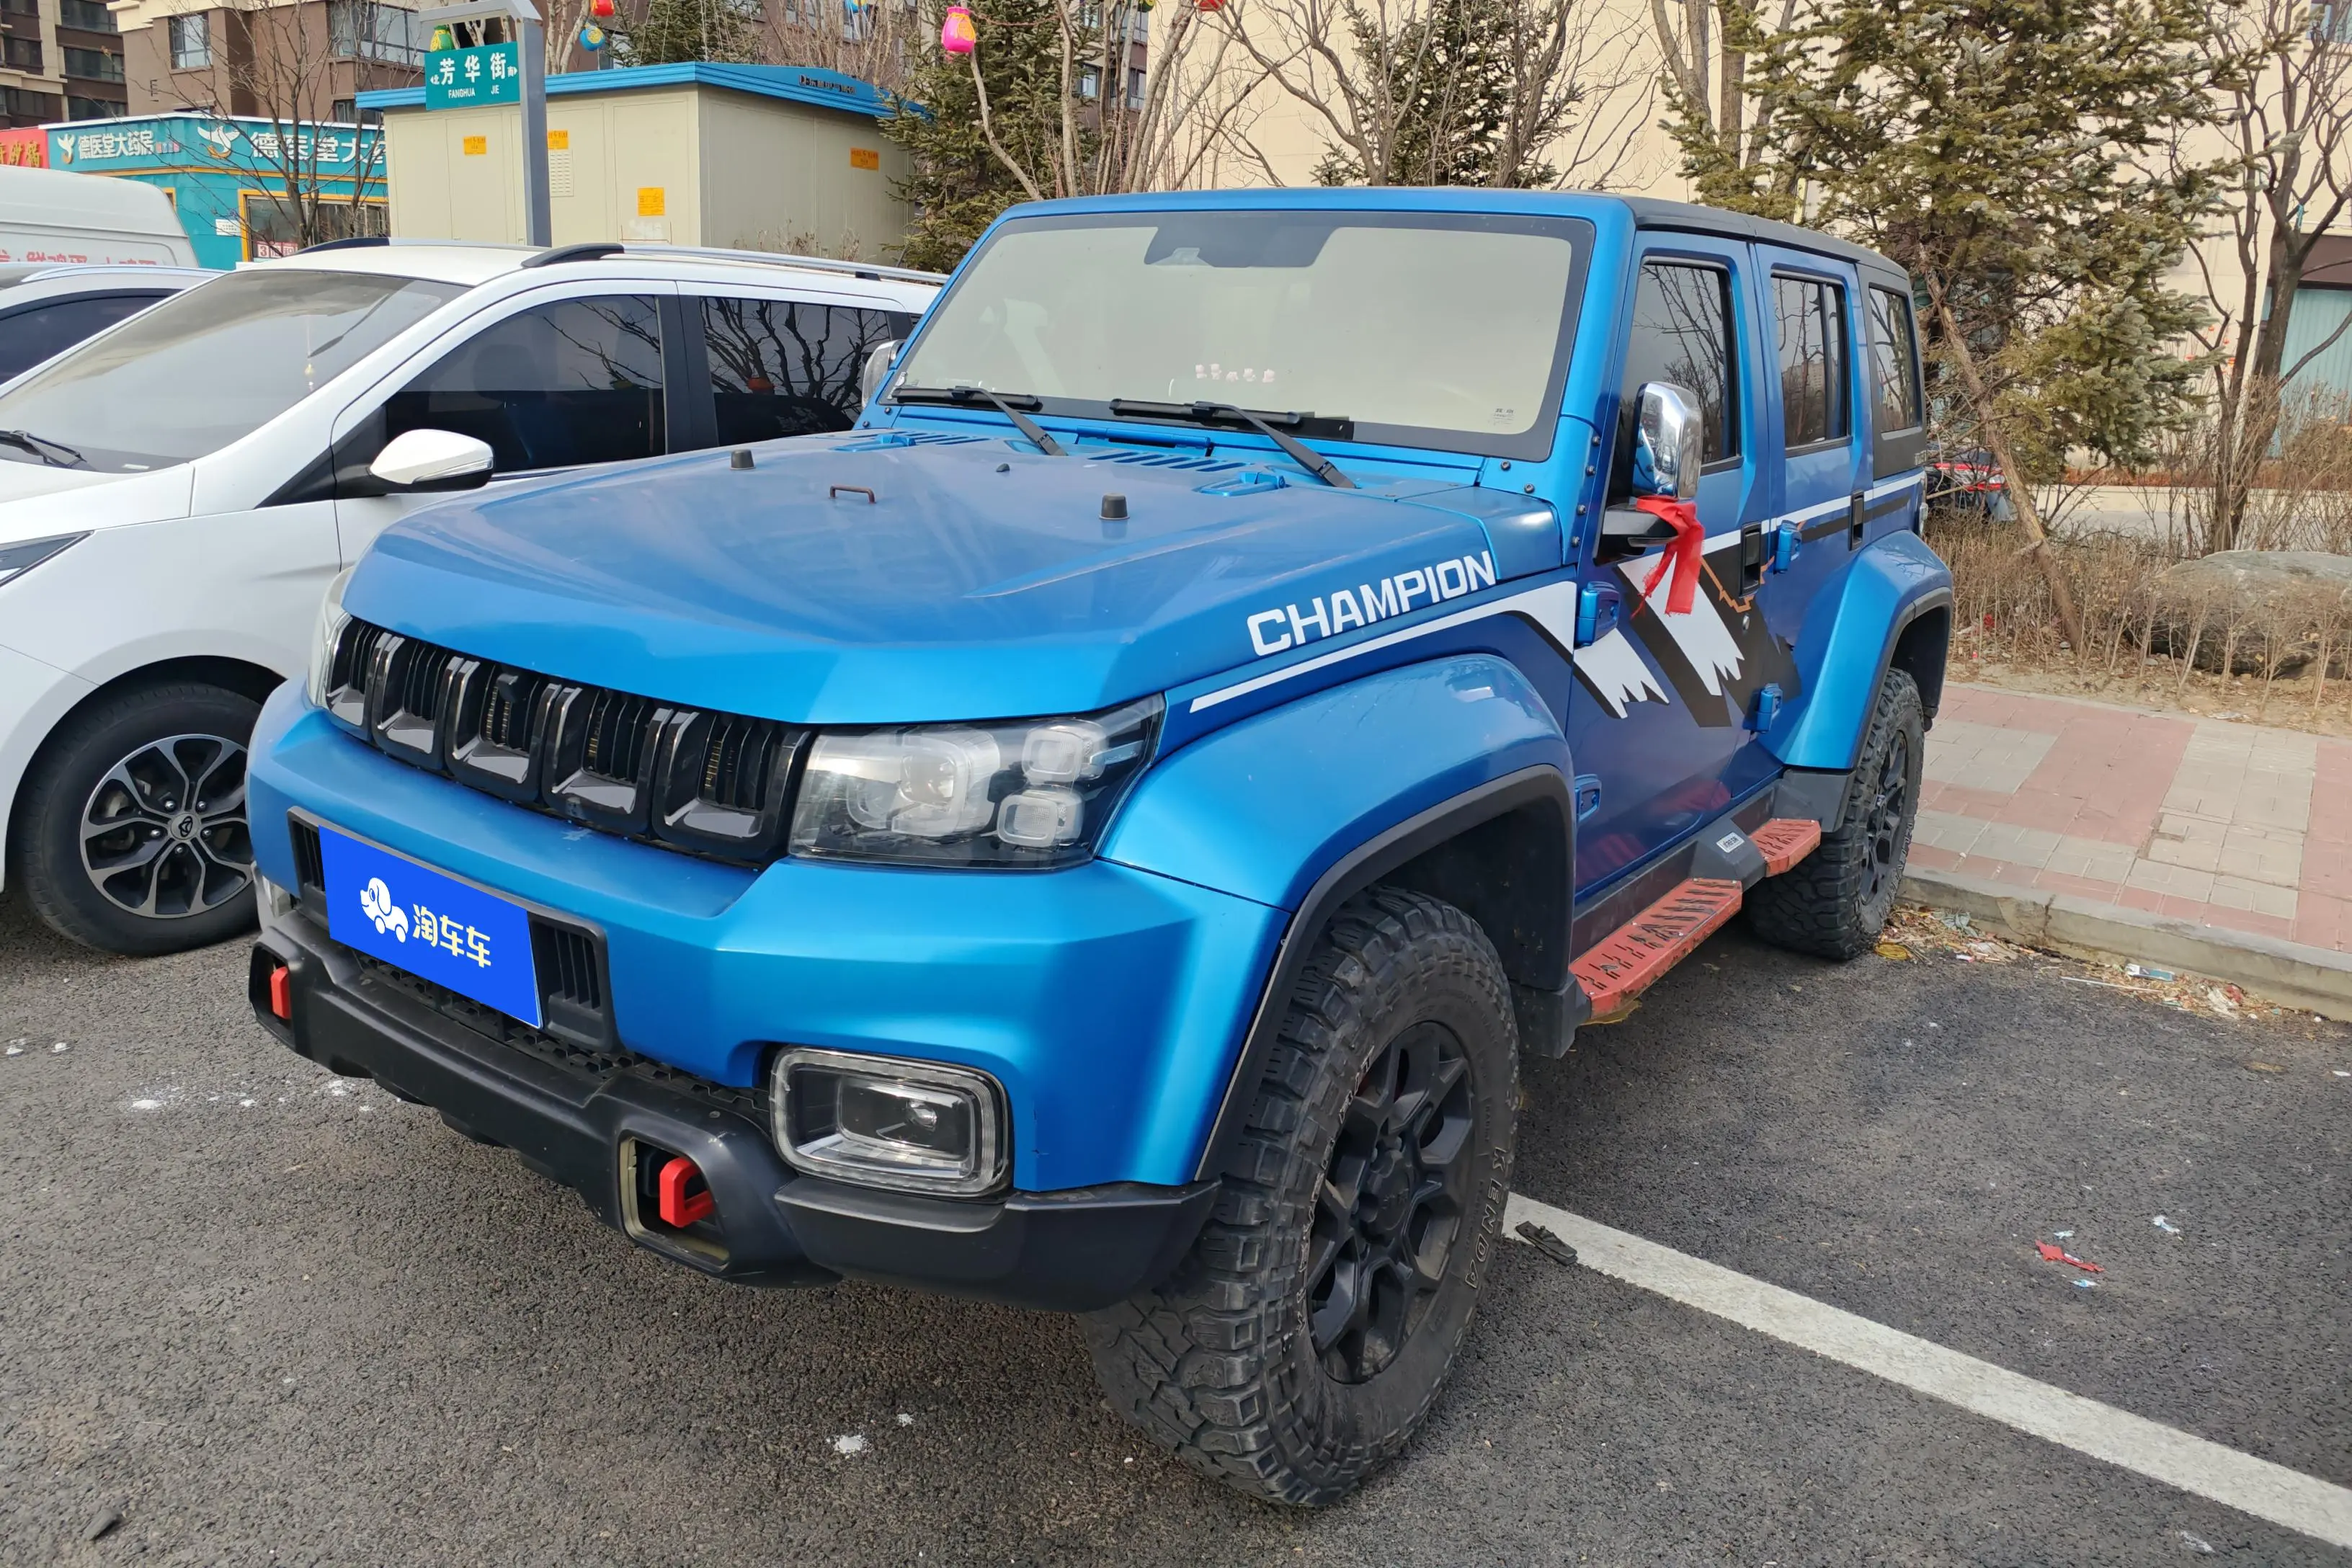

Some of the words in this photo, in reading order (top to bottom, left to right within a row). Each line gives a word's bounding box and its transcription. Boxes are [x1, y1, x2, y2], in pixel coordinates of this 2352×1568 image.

[440, 53, 506, 85] 芳华街
[448, 88, 476, 99] FANGHUA
[491, 85, 499, 94] JIE
[78, 130, 153, 159] 德医堂大药房
[1247, 551, 1496, 656] CHAMPION
[1464, 1146, 1507, 1288] KENDA
